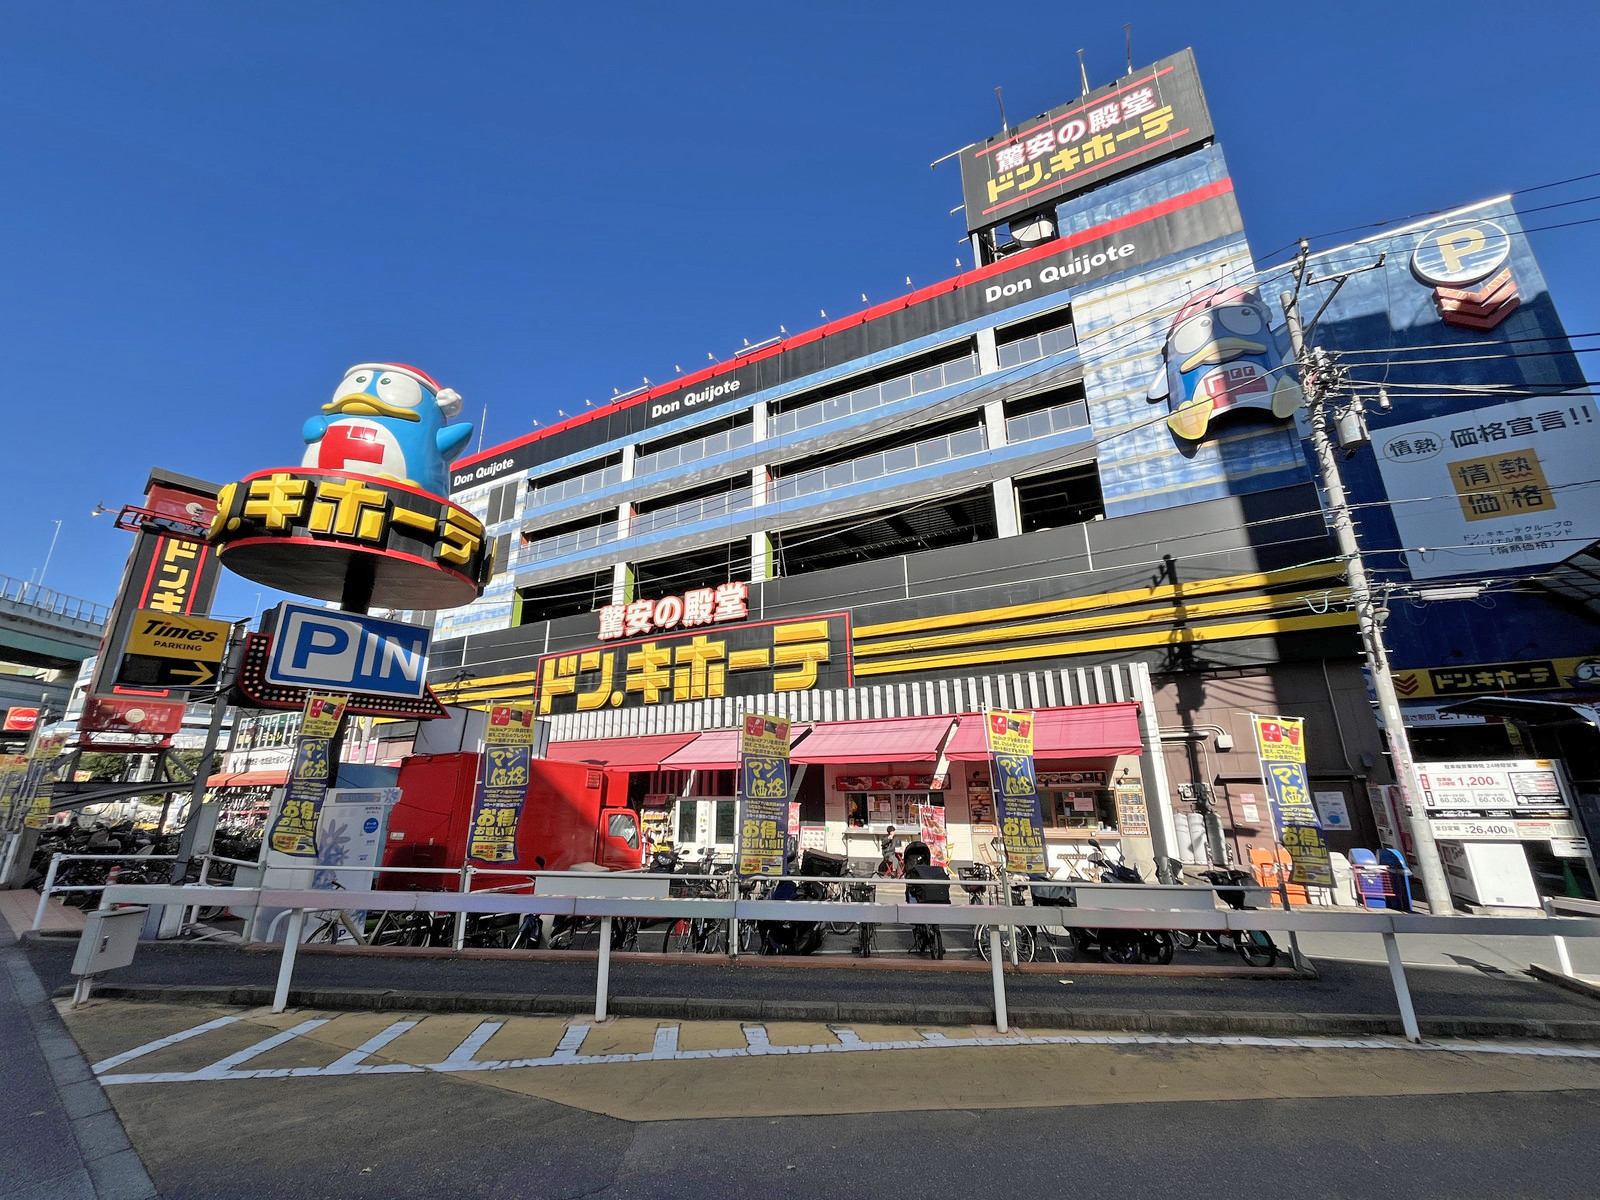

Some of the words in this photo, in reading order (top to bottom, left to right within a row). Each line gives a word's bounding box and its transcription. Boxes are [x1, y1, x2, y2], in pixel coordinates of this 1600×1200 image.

[995, 87, 1157, 173] 驚安の殿堂
[1435, 228, 1486, 273] P
[985, 277, 1032, 304] Don
[1039, 241, 1136, 285] Quijote
[652, 400, 680, 418] Don
[684, 379, 741, 407] Quijote
[1389, 437, 1438, 457] 情熱
[453, 472, 474, 487] Don
[475, 458, 515, 478] Quijote
[1458, 456, 1533, 487] 情熱
[1468, 484, 1544, 515] 価格
[597, 581, 749, 640] 驚安の殿堂
[142, 619, 219, 643] Times
[153, 640, 203, 652] PARKING
[360, 632, 423, 682] IN
[490, 746, 523, 767] マジ
[748, 758, 780, 778] マジ
[490, 767, 527, 786] 価格
[751, 778, 785, 797] 価格
[742, 819, 785, 839] お得に
[1003, 817, 1040, 837] お得に
